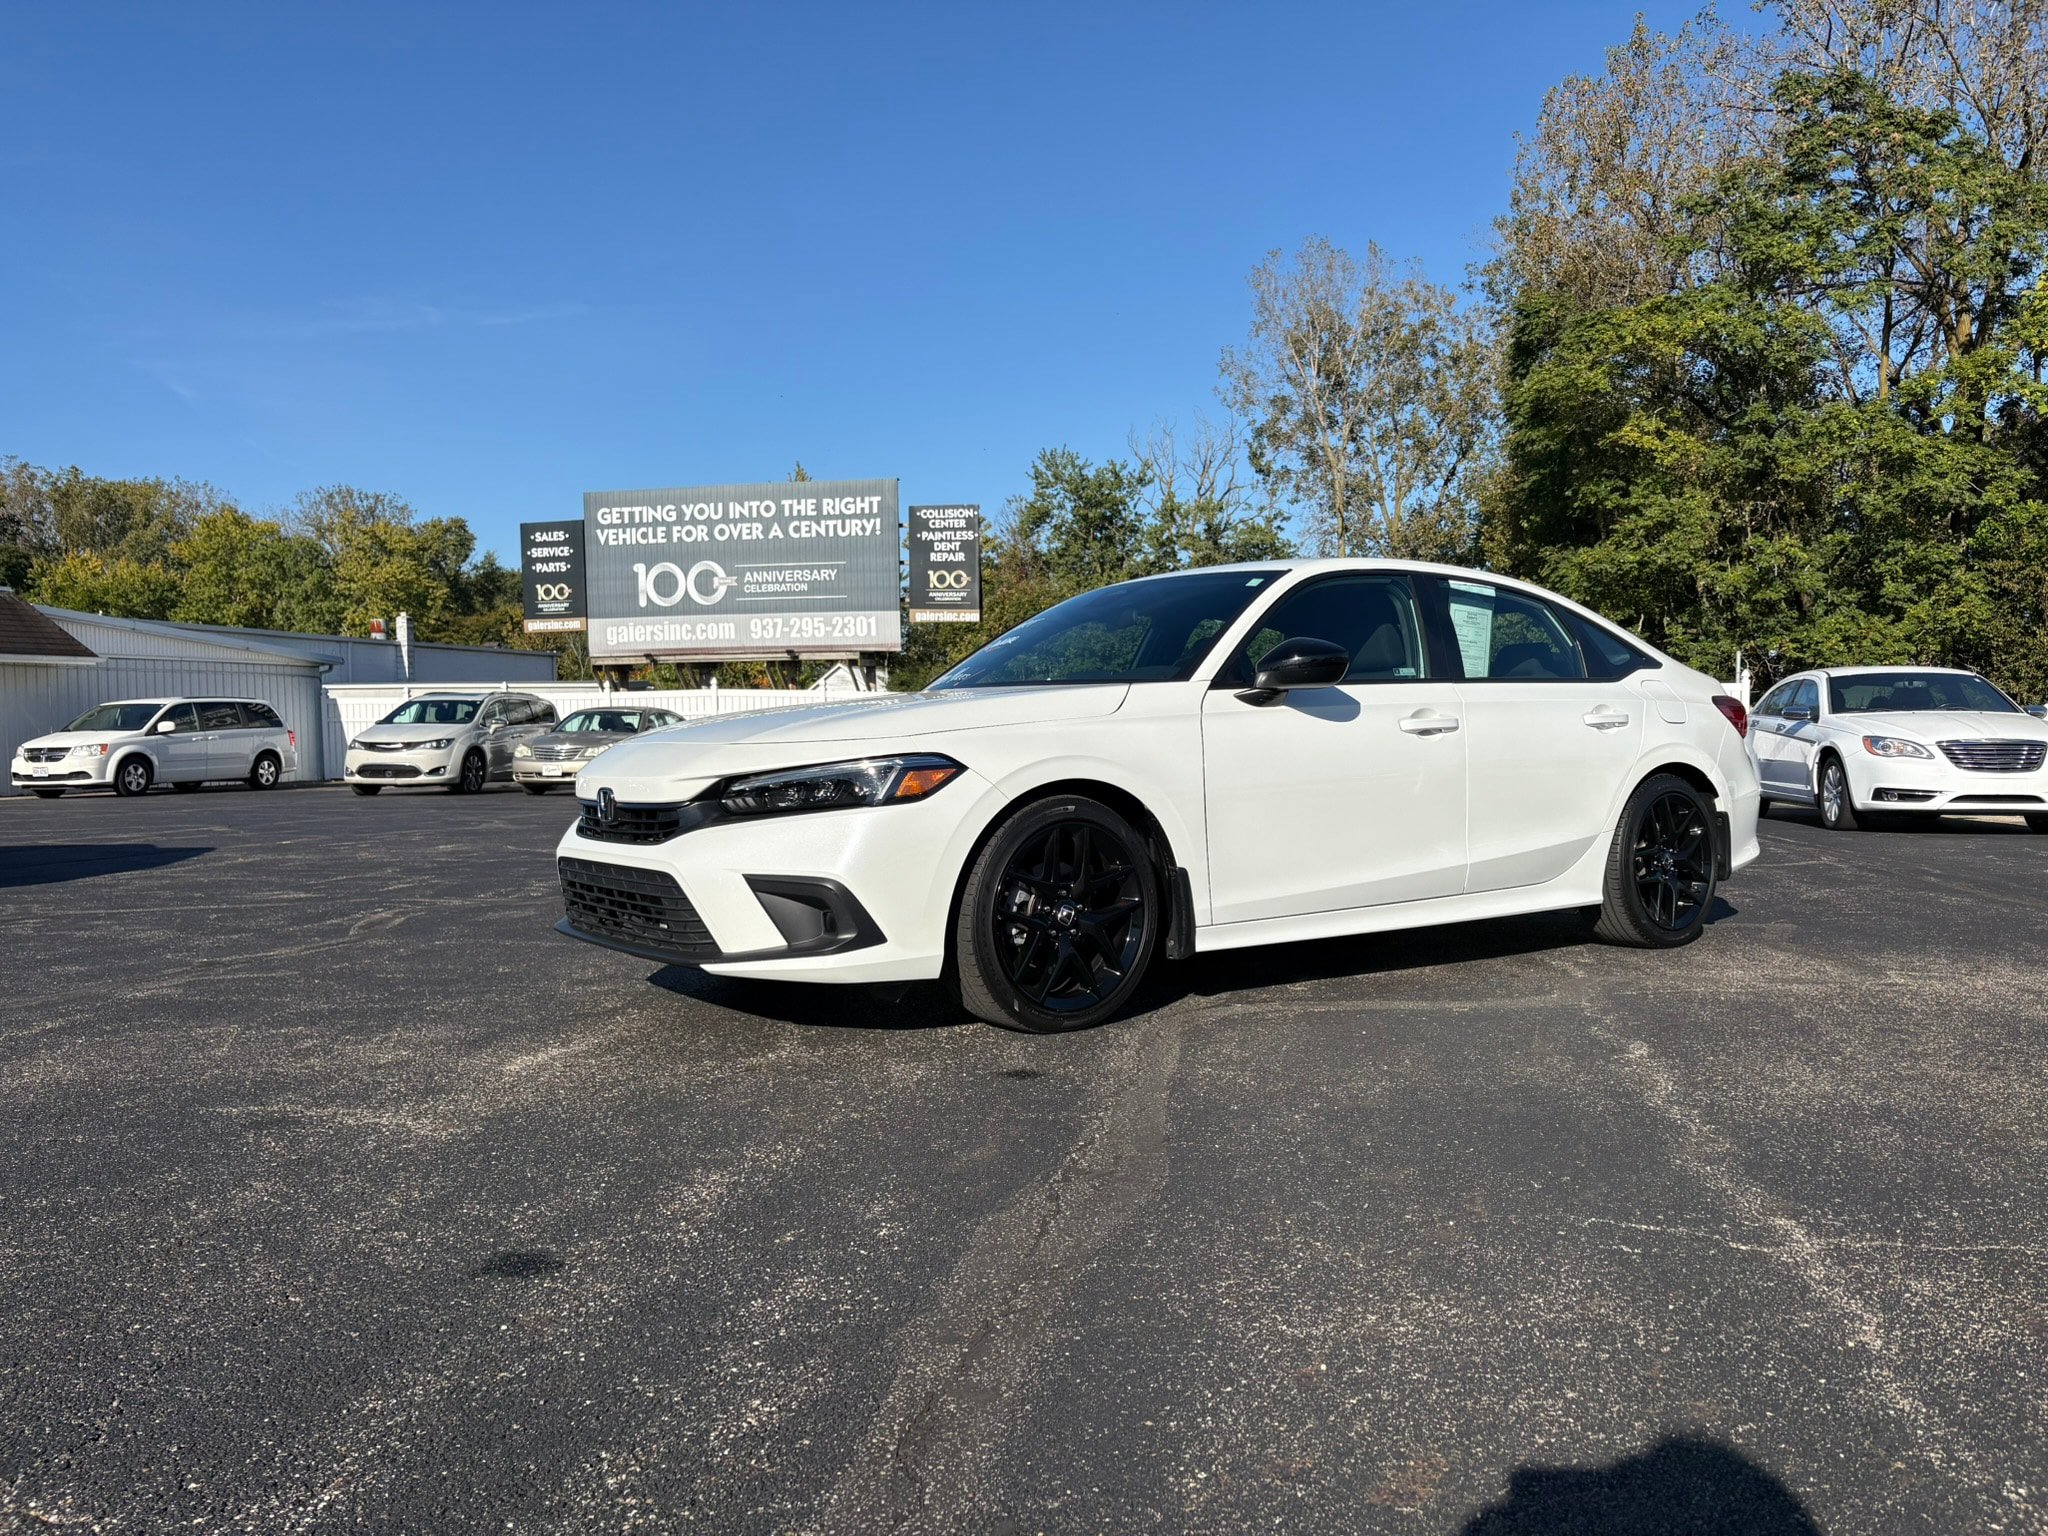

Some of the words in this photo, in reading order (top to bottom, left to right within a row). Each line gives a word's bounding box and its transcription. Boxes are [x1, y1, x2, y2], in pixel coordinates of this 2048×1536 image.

[597, 505, 677, 525] GETTING
[681, 502, 723, 521] YOU
[729, 500, 777, 519] INTO
[781, 498, 817, 517] THE
[822, 496, 881, 516] RIGHT
[920, 508, 974, 519] COLLISION
[929, 519, 966, 529] CENTER
[534, 531, 565, 543] SALES
[596, 526, 667, 546] VEHICLE
[672, 524, 709, 543] FOR
[713, 522, 764, 541] OVER
[768, 521, 784, 539] A
[788, 517, 881, 539] CENTURY!
[921, 530, 974, 541] PAINTLESS
[531, 546, 570, 558] SERVICE
[934, 541, 961, 552] DENT
[930, 552, 966, 562] REPAIR
[535, 562, 567, 573] PARTS
[744, 569, 837, 584] ANNIVERSARY
[927, 570, 967, 589] 100
[632, 560, 728, 608] 100
[744, 583, 808, 593] CELEBRATION
[535, 583, 569, 601] 100
[527, 620, 581, 632] gaiersinc.com
[606, 621, 736, 646] gaiersinc.com
[750, 616, 877, 639] 937-295-2301
